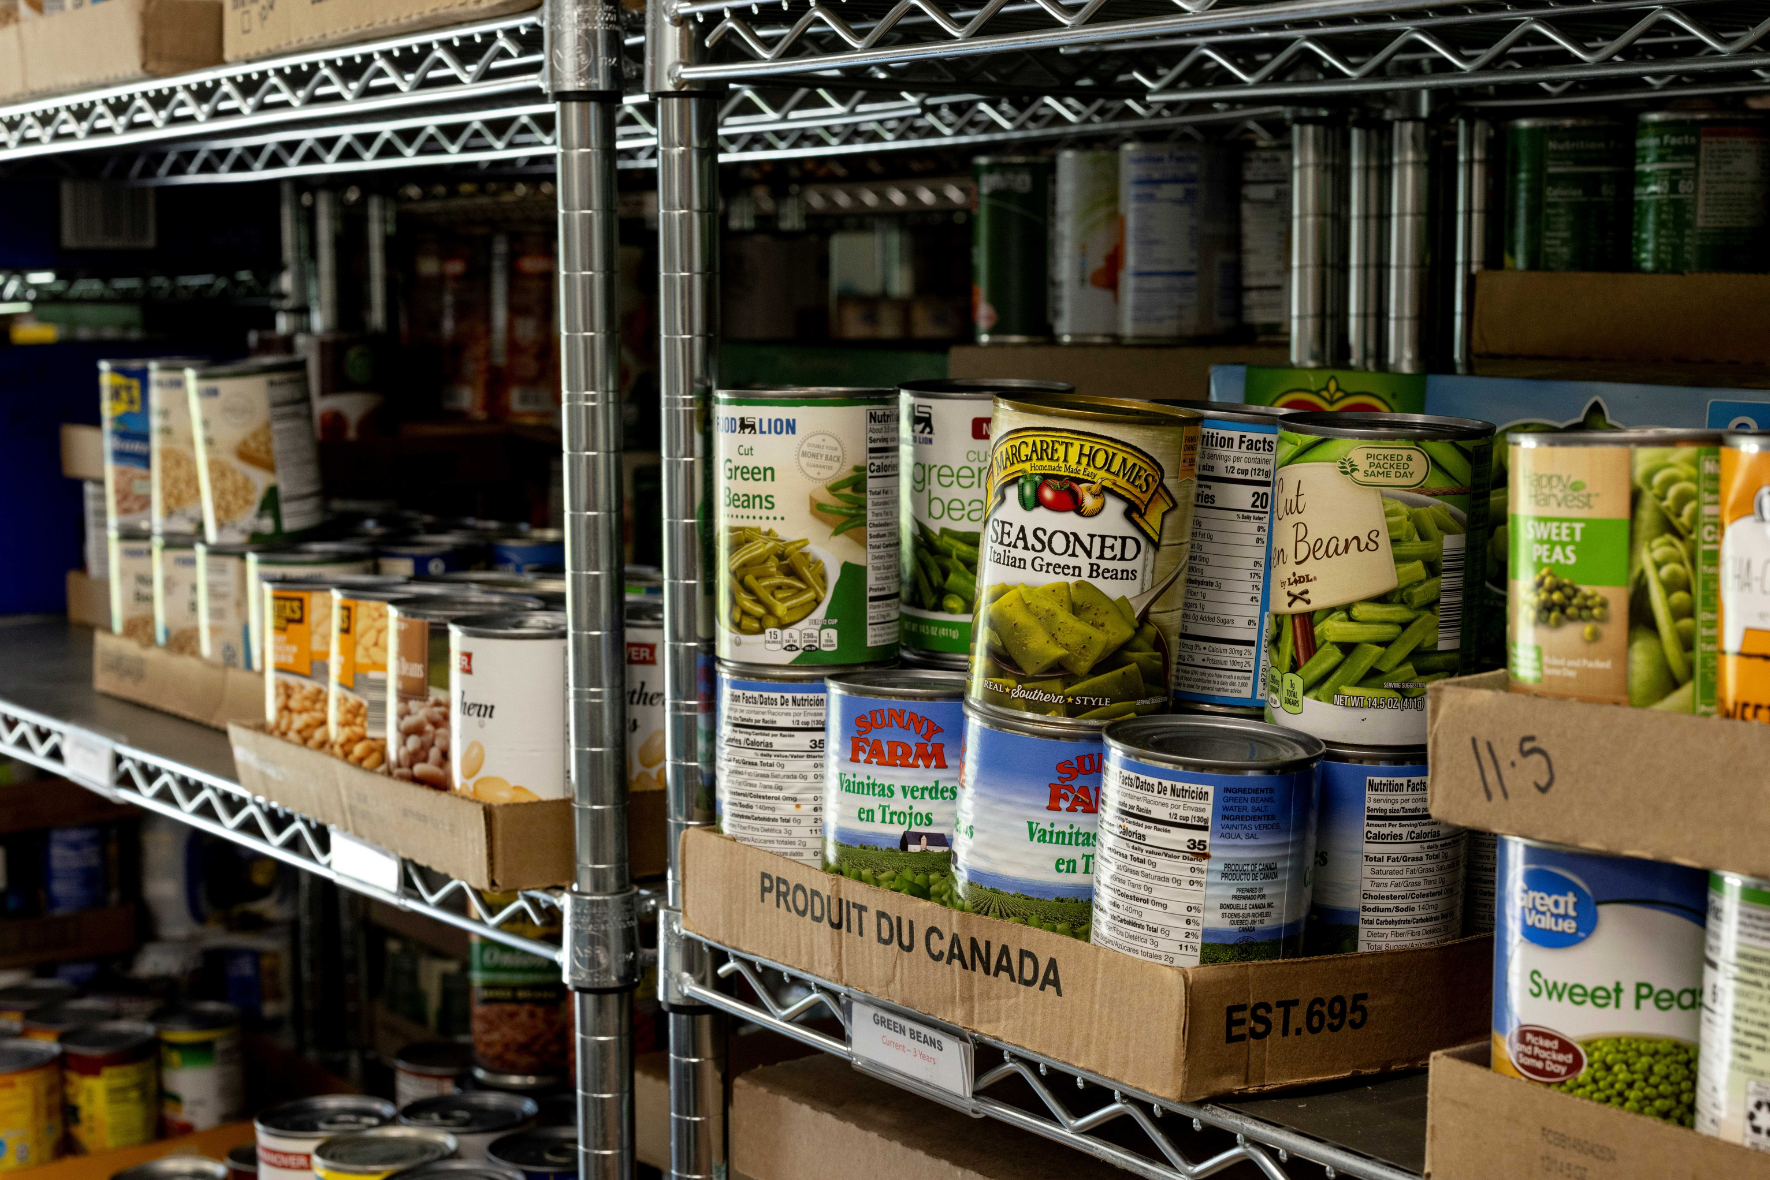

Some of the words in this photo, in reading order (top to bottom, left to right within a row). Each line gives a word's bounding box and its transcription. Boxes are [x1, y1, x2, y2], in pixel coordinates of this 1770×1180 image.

[759, 418, 796, 435] LION
[919, 437, 933, 445] LION
[1238, 435, 1274, 452] Facts
[738, 445, 754, 456] Cut
[801, 450, 823, 460] MONEY
[825, 454, 841, 463] BACK
[966, 450, 988, 462] cu
[1366, 453, 1403, 461] PICKED
[806, 462, 833, 470] GUARANTEE
[869, 462, 898, 473] Calories
[994, 439, 1075, 472] MARGARET
[1076, 443, 1156, 494] HOLMES
[1207, 453, 1232, 464] servings
[1233, 456, 1242, 464] per
[1244, 456, 1272, 466] container
[1369, 462, 1410, 470] PACKED
[724, 459, 775, 482] Green
[913, 462, 987, 492] gree
[1030, 462, 1062, 473] Homemade
[1063, 464, 1081, 475] Made
[1082, 467, 1098, 480] Easy
[1202, 463, 1215, 472] size
[1237, 467, 1249, 477] cup
[1250, 468, 1271, 478] (121g)
[1364, 470, 1392, 478] SAME
[1394, 470, 1414, 479] DAY
[724, 487, 775, 510] Beans
[928, 489, 984, 522] bea
[1251, 491, 1269, 510] 20
[1276, 477, 1306, 521] Cut
[1526, 519, 1586, 542] SWEET
[990, 518, 1142, 563] SEASONED
[1292, 522, 1379, 565] Beans
[1532, 544, 1577, 565] PEAS
[989, 546, 1028, 571] Italian
[1031, 556, 1083, 578] Green
[1088, 562, 1138, 581] Beans
[769, 631, 778, 640] 15
[742, 692, 778, 707] Facts/Datos
[780, 695, 789, 707] De
[791, 694, 824, 707] Nutrición
[983, 679, 1004, 693] REAL
[1011, 684, 1065, 705] Southern
[1075, 696, 1111, 707] STYLE
[460, 690, 496, 719] hern
[1333, 694, 1349, 706] NET
[1351, 696, 1365, 708] WT
[1367, 696, 1385, 709] 14.5
[1387, 697, 1399, 709] OZ
[1400, 697, 1425, 711] (411g)
[855, 708, 944, 742] SUNNY
[809, 740, 824, 749] 35
[850, 737, 948, 769] FARM
[839, 772, 895, 798] Vainitas
[900, 780, 958, 800] verdes
[1157, 781, 1168, 796] De
[1170, 783, 1209, 802] Nutrición
[1223, 787, 1275, 795] INGREDIENTS:
[1368, 779, 1404, 793] Nutrition
[1046, 783, 1101, 814] FA
[1222, 796, 1249, 804] GREEN
[1373, 796, 1399, 805] servings
[1400, 797, 1410, 805] per
[1182, 803, 1206, 813] Envase
[1366, 806, 1388, 815] Serving
[1389, 806, 1421, 814] size/Tamaño
[857, 806, 875, 823] en
[878, 803, 933, 831] Trojos
[1221, 814, 1276, 822] INGREDIENTES:
[1220, 823, 1253, 831] VAINITAS
[1365, 830, 1403, 841] Calories
[1406, 828, 1441, 840] /Calorías
[1186, 838, 1207, 851] 35
[1219, 832, 1243, 841] AGUA,
[1055, 857, 1077, 874] en
[1364, 855, 1384, 863] Total
[1386, 854, 1424, 863] Fat/Grasa
[1223, 863, 1250, 872] PRODUCT
[1251, 863, 1258, 871] OF
[1258, 862, 1278, 871] CANADA
[1370, 867, 1404, 876] Saturated
[1405, 866, 1435, 875] Fat/Grasa
[1220, 873, 1251, 881] PRODUCTO
[1251, 873, 1259, 881] DE
[1259, 871, 1278, 880] CANADA
[1370, 880, 1388, 888] Trans
[1389, 879, 1421, 888] Fat/Grasa
[1362, 890, 1443, 901] Cholesterol/Colesterol
[1514, 880, 1578, 917] Great
[1248, 902, 1266, 910] CANADA
[1361, 905, 1416, 913] Sodium/Sodio
[1417, 903, 1439, 911] 140mg
[1361, 917, 1375, 926] Total
[1524, 908, 1578, 935] Value
[760, 871, 868, 938] PRODUIT
[876, 910, 915, 953] DU
[924, 926, 1063, 998] CANADA
[1366, 931, 1390, 940] Dietary
[1390, 929, 1421, 938] Fiber/Fibra
[1528, 969, 1624, 1009] Sweet
[1225, 992, 1369, 1044] EST.695
[873, 1013, 906, 1036] GREEN
[909, 1028, 944, 1052] BEANS
[1525, 1032, 1559, 1050] Picked
[881, 1035, 906, 1054] Current
[912, 1047, 918, 1058] 3
[918, 1049, 937, 1065] Years
[1533, 1045, 1573, 1064] Packed
[1517, 1053, 1544, 1070] Same
[1545, 1060, 1568, 1076] Day
